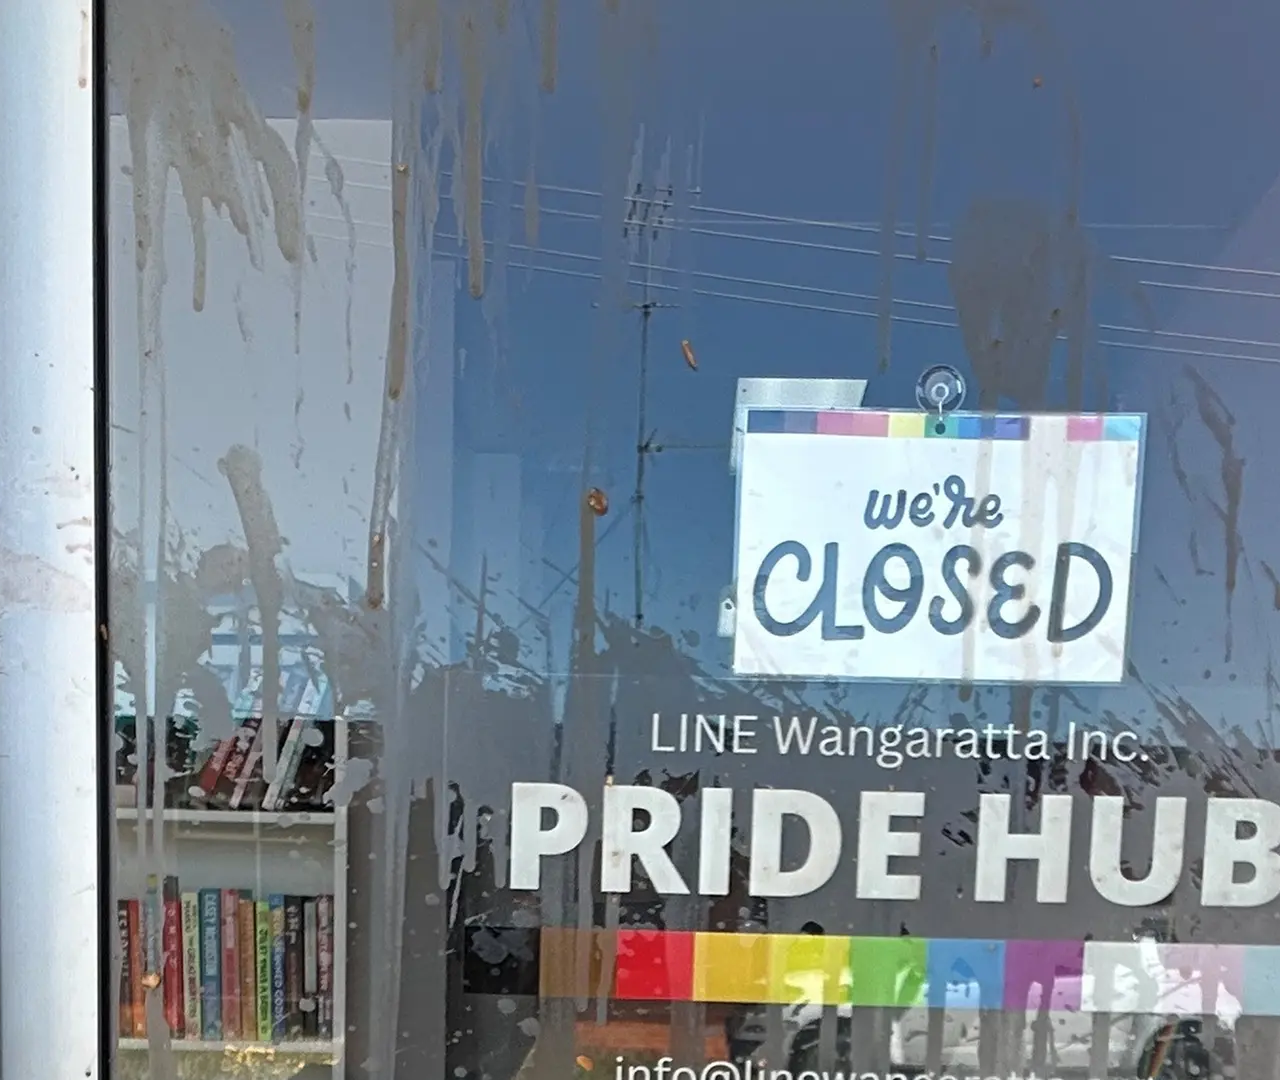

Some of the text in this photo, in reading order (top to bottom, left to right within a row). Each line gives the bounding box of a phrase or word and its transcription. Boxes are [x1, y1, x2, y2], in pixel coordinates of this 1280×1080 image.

[864, 475, 1004, 529] we're
[753, 540, 1113, 643] CLOSED
[651, 713, 1150, 767] LINE Wangaratta Inc.
[509, 781, 926, 901] PRIDE
